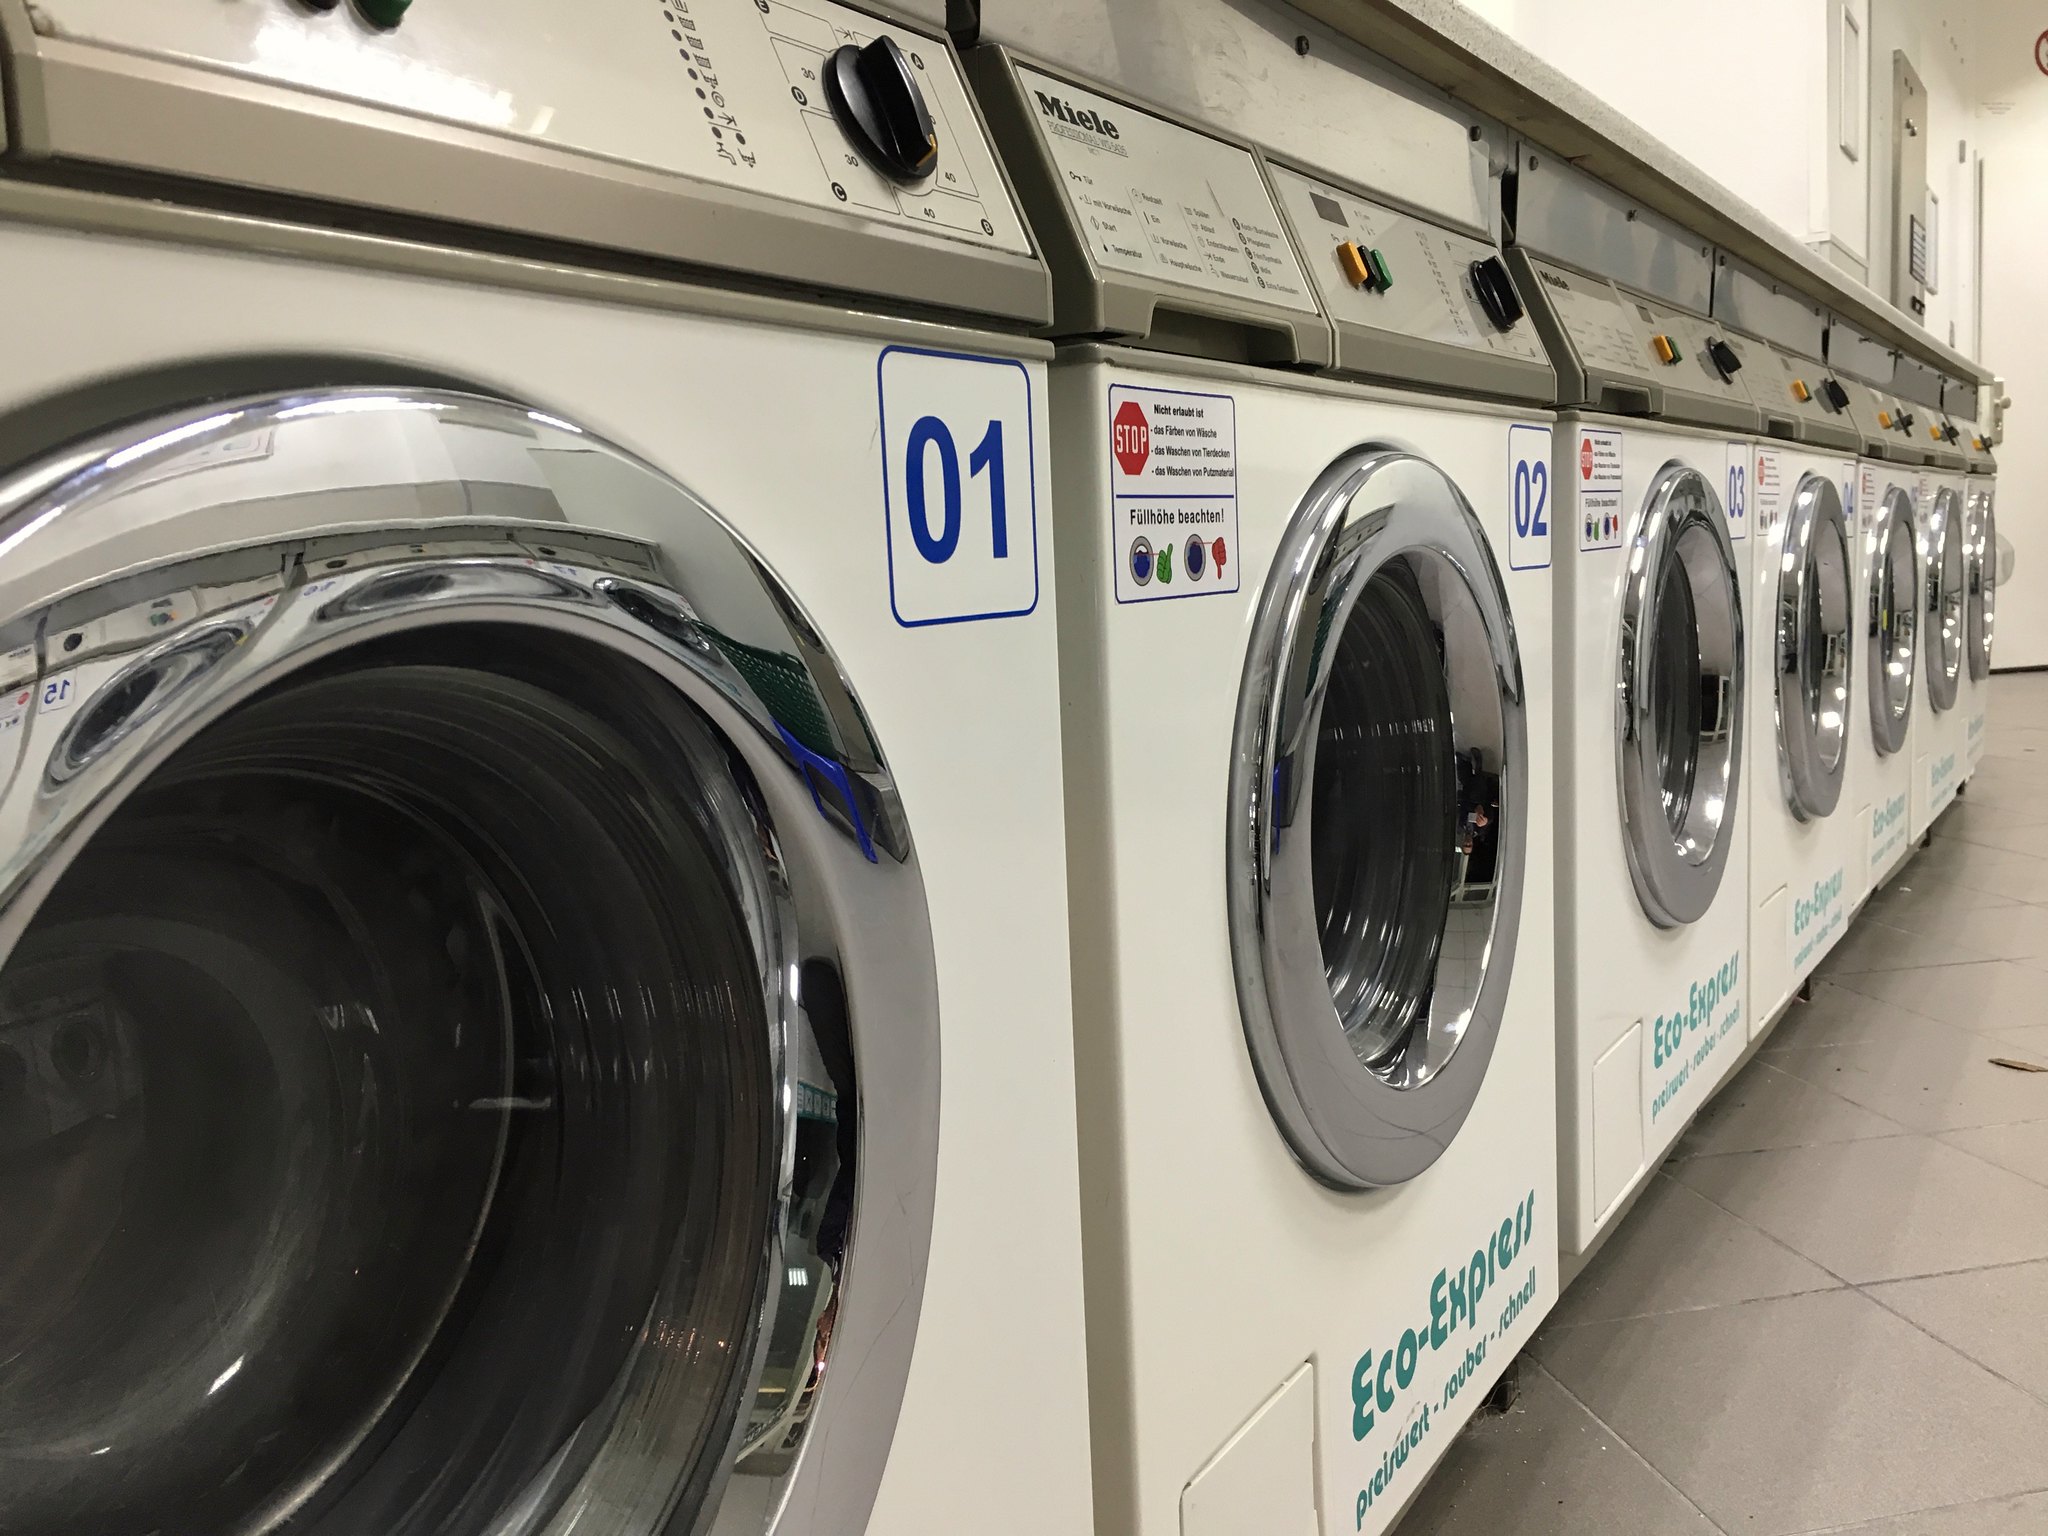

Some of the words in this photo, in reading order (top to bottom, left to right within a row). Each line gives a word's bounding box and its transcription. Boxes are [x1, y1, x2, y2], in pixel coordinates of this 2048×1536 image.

[801, 67, 816, 81] 30
[1034, 89, 1120, 140] Miele
[844, 153, 859, 168] 30
[944, 172, 956, 183] 40
[923, 207, 936, 219] 40
[1154, 404, 1171, 416] Nicht
[1172, 406, 1194, 418] erlaubt
[1196, 407, 1204, 418] ist
[1116, 423, 1147, 454] STOP
[1154, 425, 1164, 435] das
[1165, 425, 1184, 437] Färben
[1185, 429, 1195, 437] von
[1196, 427, 1217, 438] Wäsche
[1154, 445, 1165, 456] das
[1166, 445, 1190, 457] Waschen
[1192, 449, 1202, 457] von
[1203, 447, 1230, 458] Tierdecken
[1155, 465, 1165, 476] das
[1166, 466, 1191, 477] Waschen
[1192, 468, 1202, 477] von
[1203, 467, 1234, 478] Putzmaterial
[906, 415, 1009, 564] 01
[1514, 459, 1547, 538] 02
[1728, 465, 1745, 519] 03
[1130, 508, 1175, 525] Füllhöhe
[1178, 508, 1225, 524] beachten!
[1653, 950, 1739, 1069] Eco-Express
[1652, 1058, 1690, 1125] preiswert
[1693, 1030, 1717, 1072] sauber
[1351, 1189, 1535, 1443] Eco-Express
[1355, 1401, 1430, 1532] preiswert
[1443, 1333, 1487, 1410] sauber
[1498, 1265, 1536, 1339] schnell
